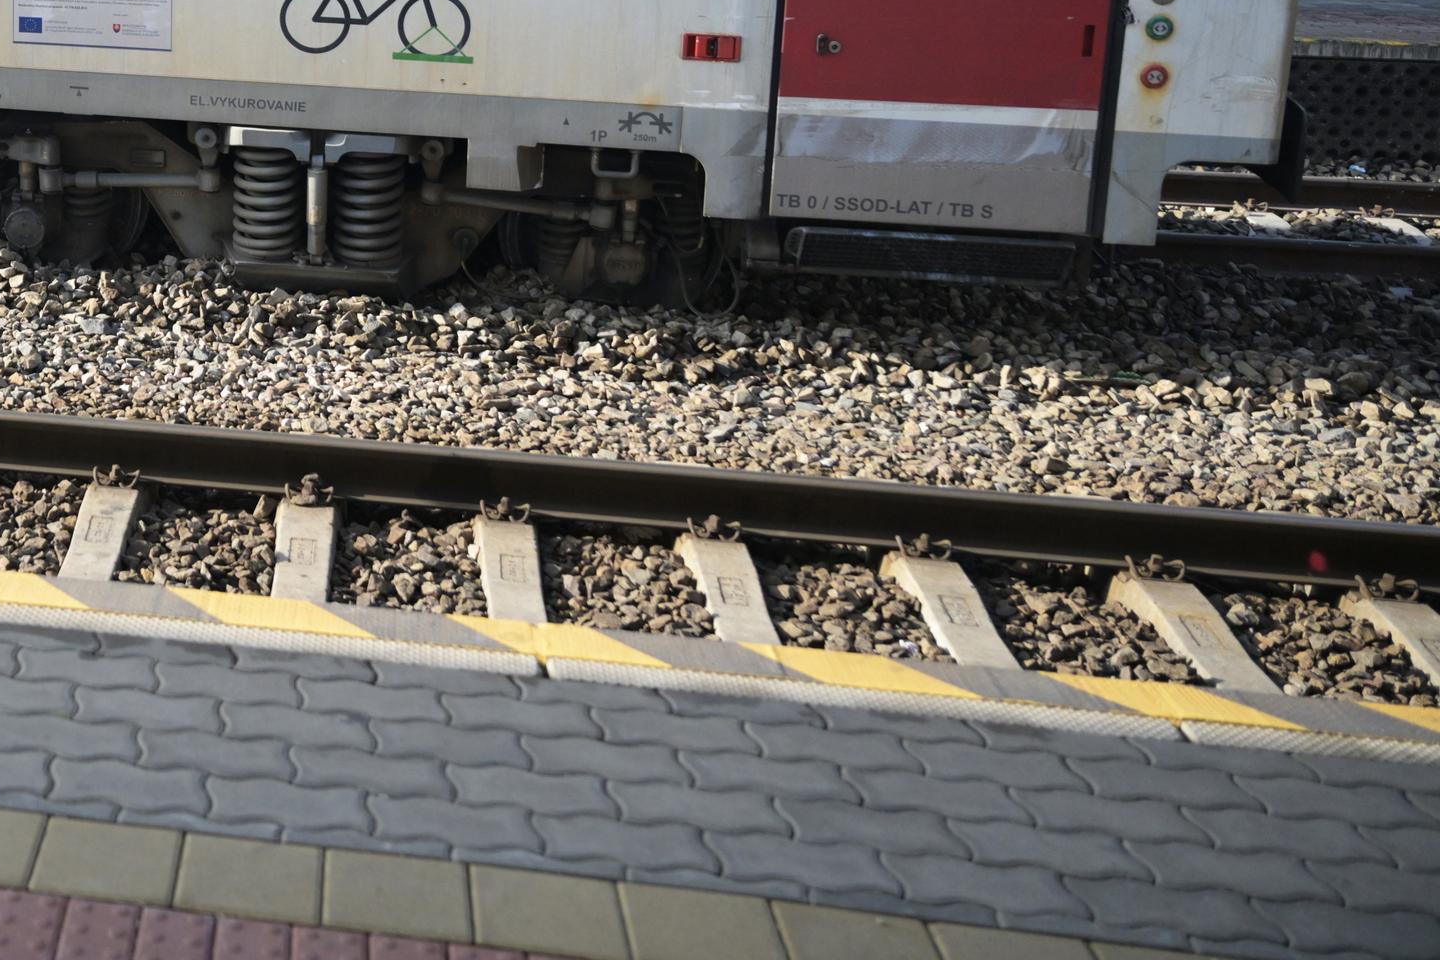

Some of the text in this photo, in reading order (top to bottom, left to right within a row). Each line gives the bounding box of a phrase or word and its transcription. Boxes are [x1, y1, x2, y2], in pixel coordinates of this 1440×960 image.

[190, 95, 306, 112] EL.VYKUROVANIE
[590, 129, 608, 142] 1P
[633, 133, 657, 142] 250m
[777, 193, 801, 208] TB
[834, 196, 932, 215] SSOD-LAT
[949, 203, 974, 218] TB
[980, 205, 993, 219] S
